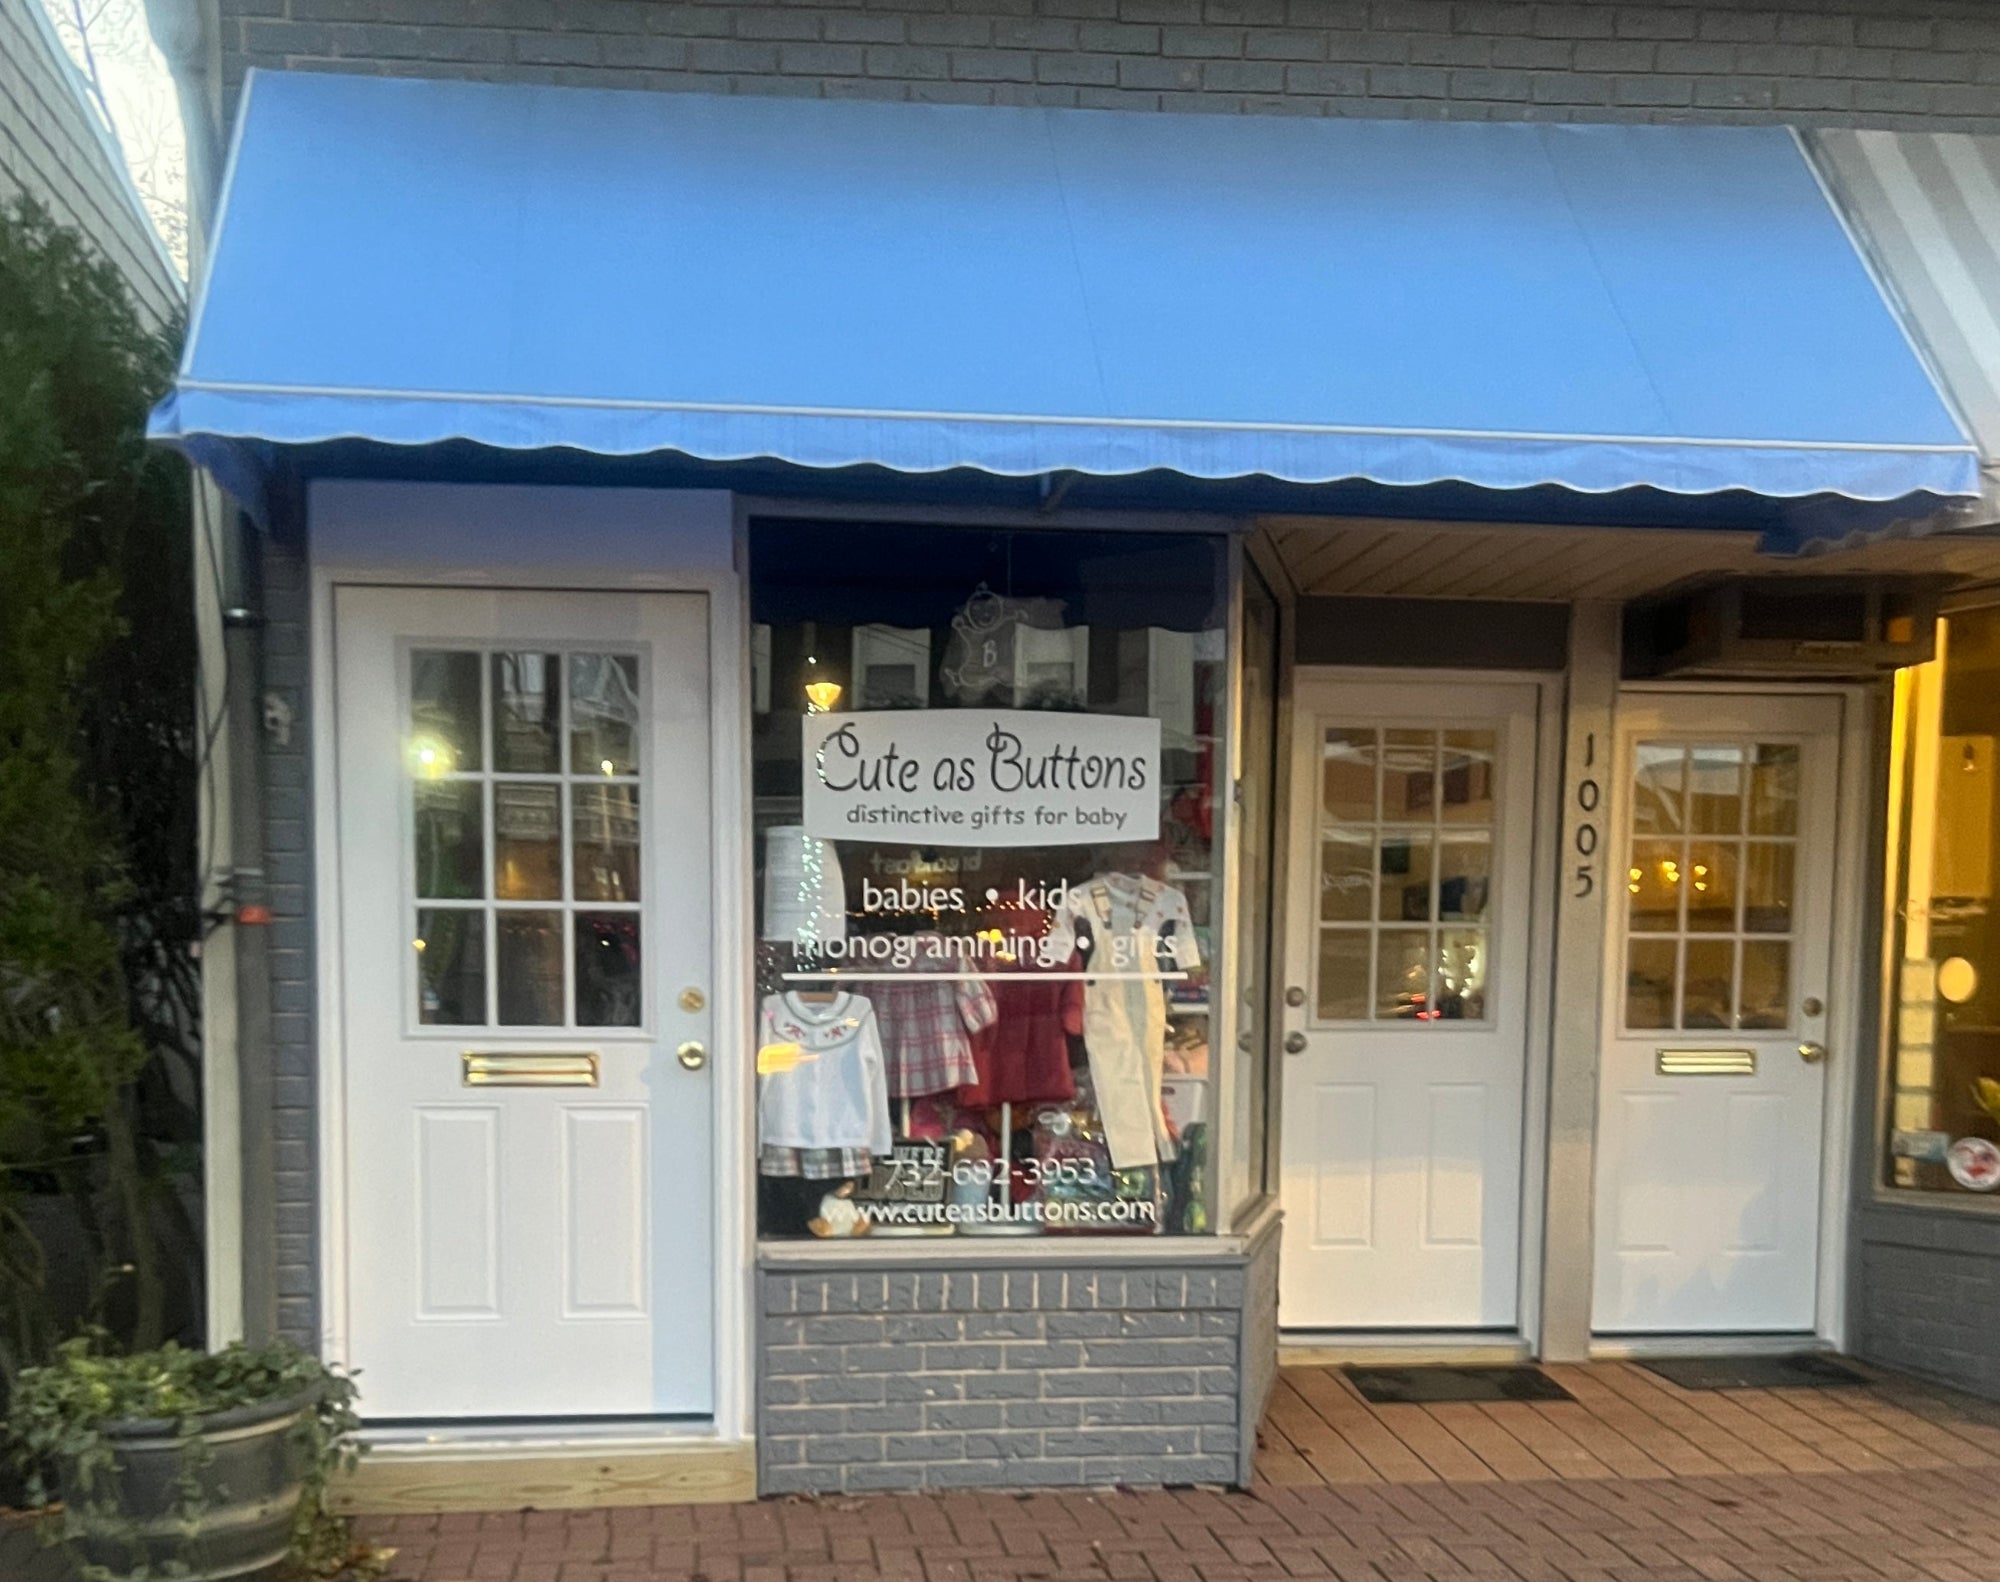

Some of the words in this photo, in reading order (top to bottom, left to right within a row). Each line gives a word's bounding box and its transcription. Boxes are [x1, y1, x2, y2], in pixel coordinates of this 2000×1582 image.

[815, 721, 920, 793] Cute
[933, 757, 975, 792] as
[985, 721, 1147, 792] Buttons
[846, 804, 965, 825] distinctive
[970, 805, 1026, 830] gifts
[1034, 805, 1068, 826] for
[1075, 805, 1128, 831] baby
[1574, 733, 1600, 898] 1005
[862, 876, 965, 912] babies
[1018, 877, 1082, 911] kids
[792, 928, 1055, 968] monogramming
[882, 1157, 1097, 1190] 732-682-3953
